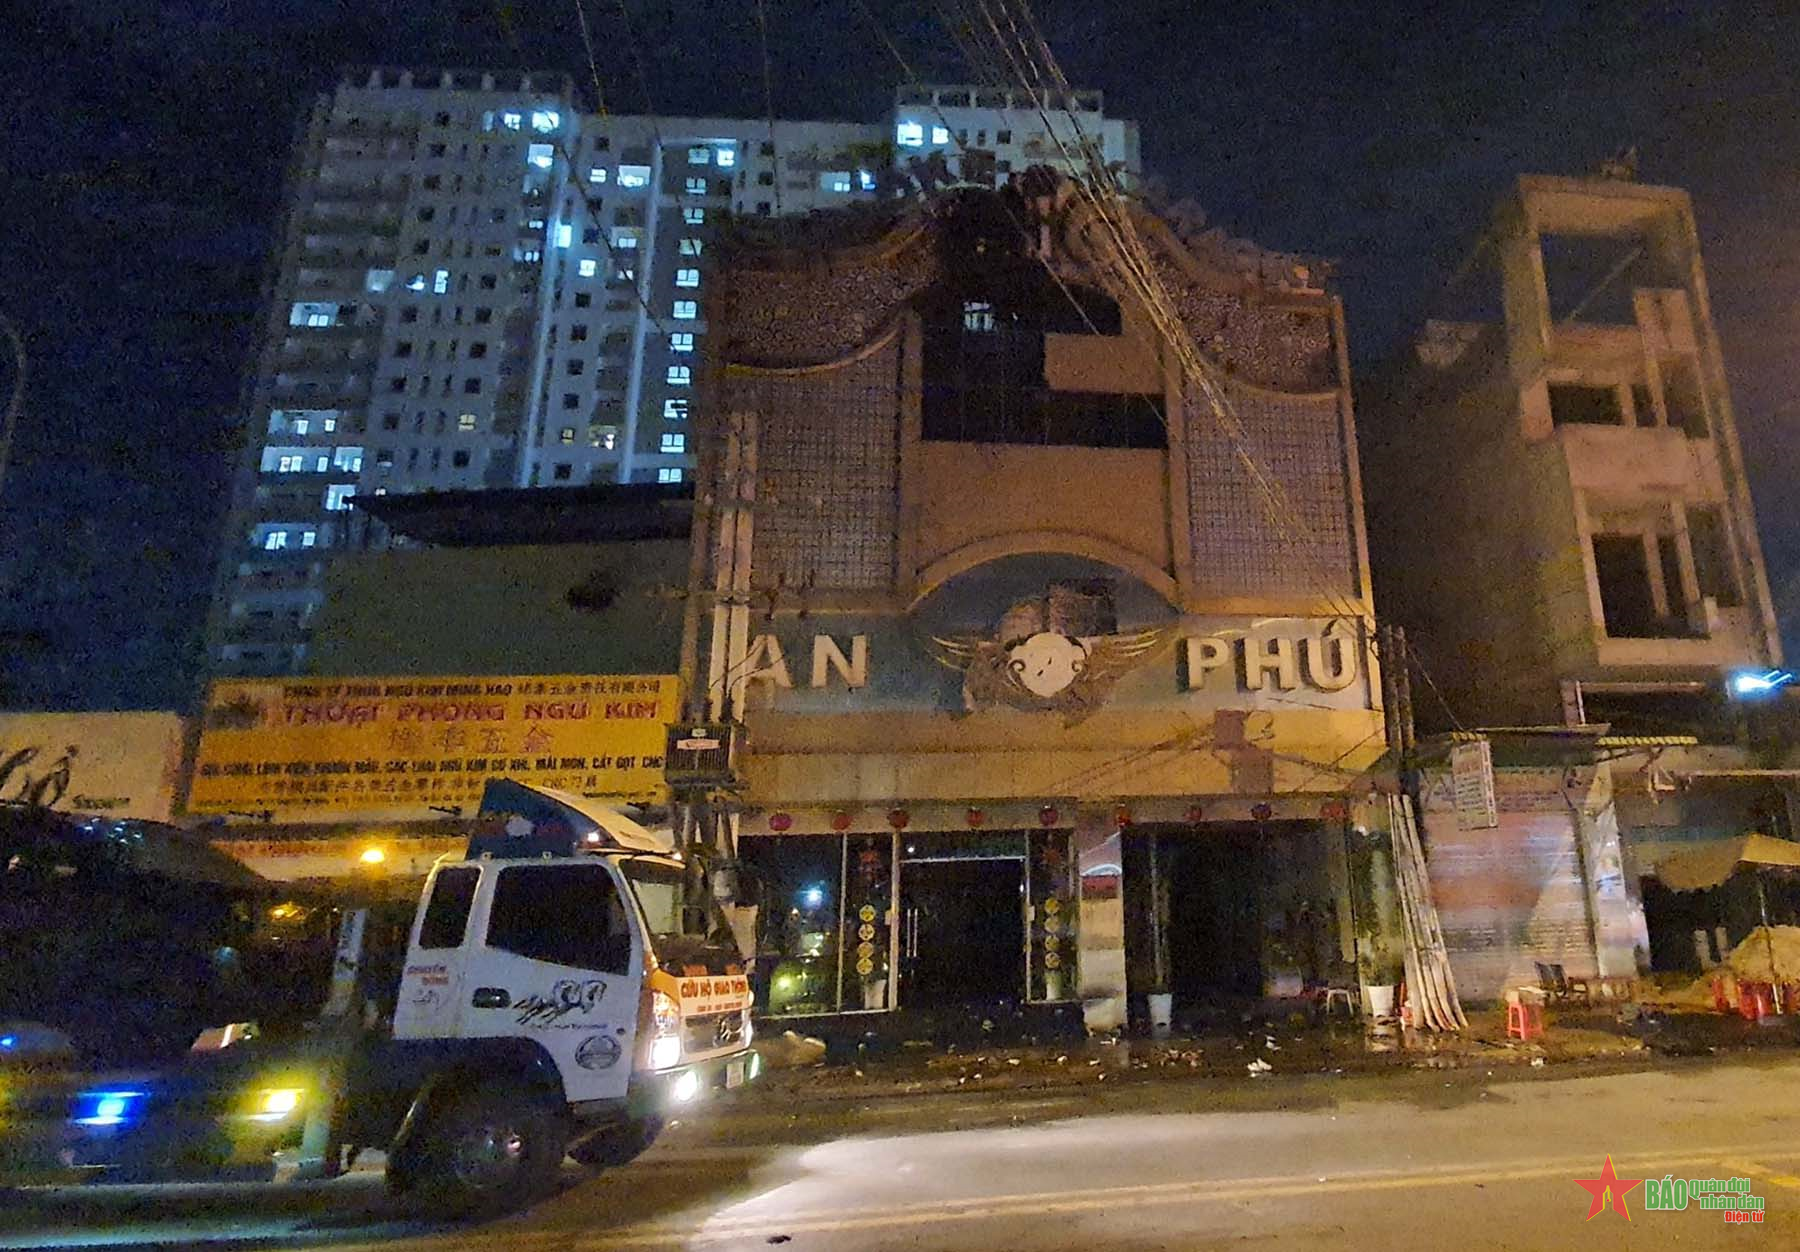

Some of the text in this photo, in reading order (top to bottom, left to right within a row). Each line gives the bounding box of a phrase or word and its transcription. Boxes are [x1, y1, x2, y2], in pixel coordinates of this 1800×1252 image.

[740, 618, 1357, 691] AN PHÚ
[605, 702, 656, 719] KIM
